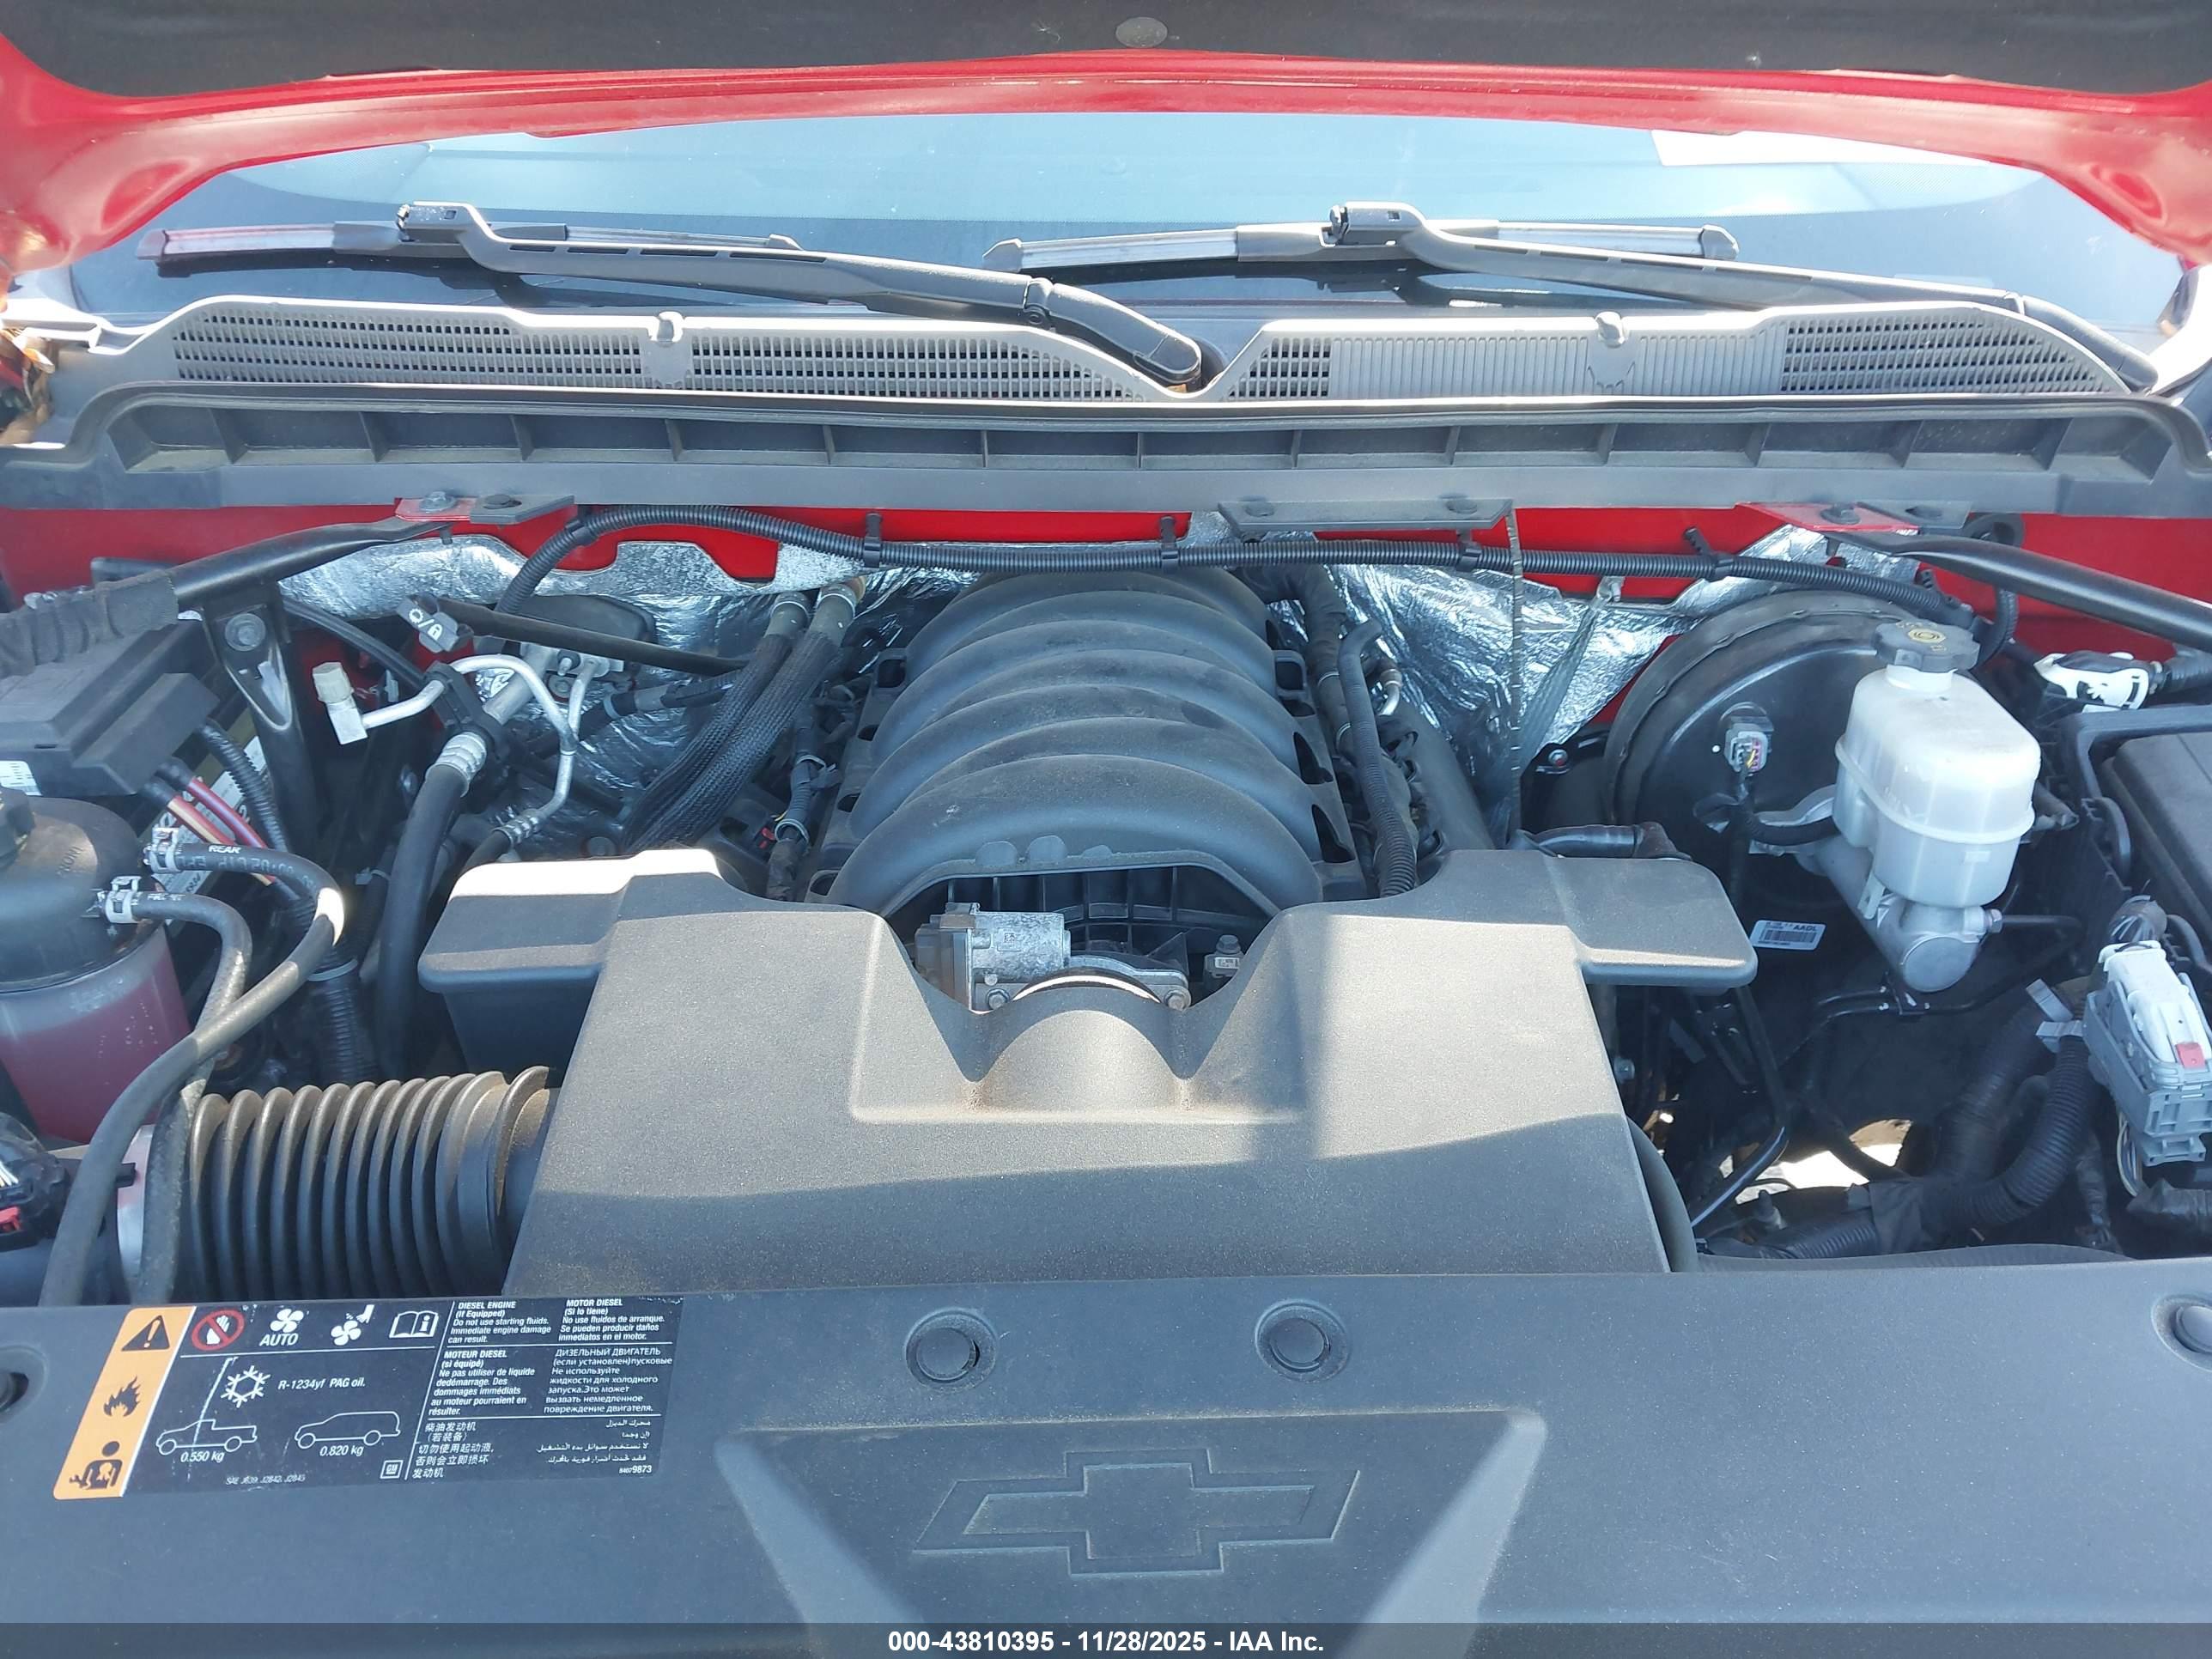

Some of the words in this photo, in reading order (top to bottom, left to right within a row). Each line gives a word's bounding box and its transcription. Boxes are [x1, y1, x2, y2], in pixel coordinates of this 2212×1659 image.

[466, 1310, 505, 1318] Equipped)
[586, 1307, 608, 1316] tiene)
[493, 1327, 519, 1335] engine
[520, 1326, 551, 1334] damage
[602, 1324, 635, 1333] producir
[259, 1334, 299, 1346] AUTO
[555, 1348, 611, 1357] ДИЗЕЛЬНЫЙ
[441, 1360, 453, 1369] (si
[453, 1359, 484, 1369] équipé)
[553, 1358, 577, 1367] (если
[507, 1368, 536, 1376] liquide
[565, 1367, 620, 1376] используйте
[277, 1378, 325, 1390] R-1234yf
[329, 1378, 350, 1388] PAG
[351, 1376, 366, 1387] oil.
[436, 1378, 490, 1387] dedémarrage.
[434, 1389, 478, 1397] dommages
[479, 1387, 521, 1395] immédiats
[472, 1396, 515, 1406] pourraient
[544, 1406, 605, 1414] повреждение
[425, 1422, 477, 1432] 柴油发动机
[319, 1446, 348, 1456] 0.820
[350, 1445, 364, 1457] kg
[180, 1451, 210, 1464] 0.550
[210, 1450, 225, 1464] kg
[412, 1468, 444, 1479] 发动机
